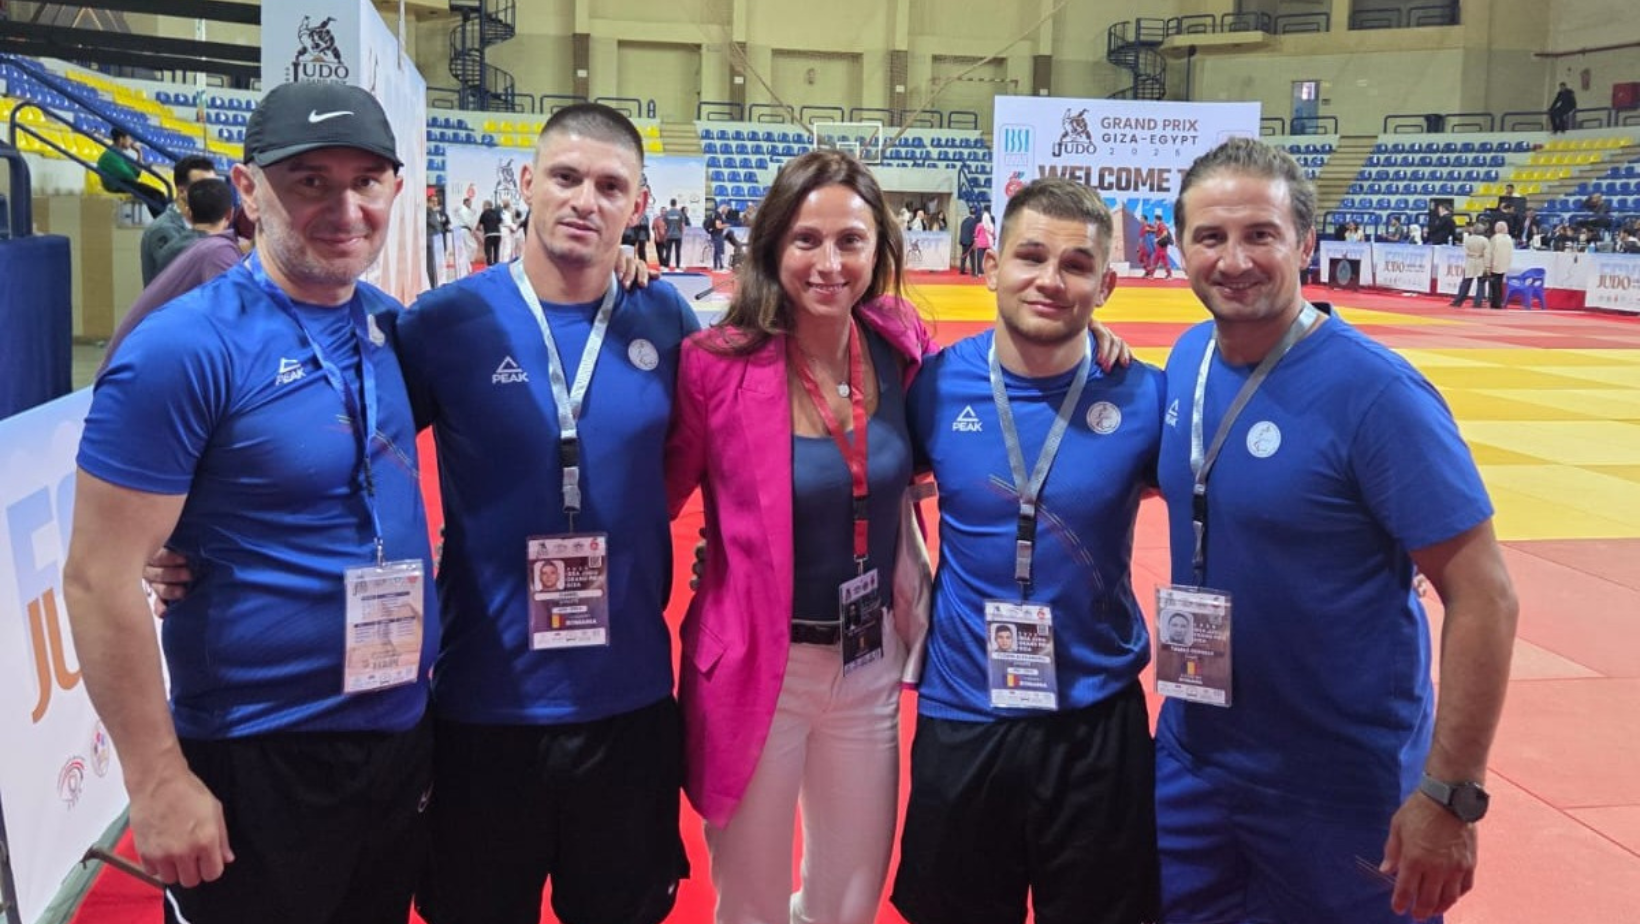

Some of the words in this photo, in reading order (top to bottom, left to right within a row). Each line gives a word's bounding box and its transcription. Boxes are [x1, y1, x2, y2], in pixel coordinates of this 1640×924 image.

[292, 61, 350, 84] JUDO
[1100, 117, 1158, 132] GRAND
[1162, 118, 1199, 132] PRIX
[1052, 142, 1098, 158] JUDO
[1038, 164, 1171, 192] WELCOME
[1596, 274, 1631, 290] JUDO
[276, 367, 306, 386] PEAK
[491, 371, 530, 385] PEAK
[952, 422, 983, 432] PEAK
[27, 587, 83, 725] JU
